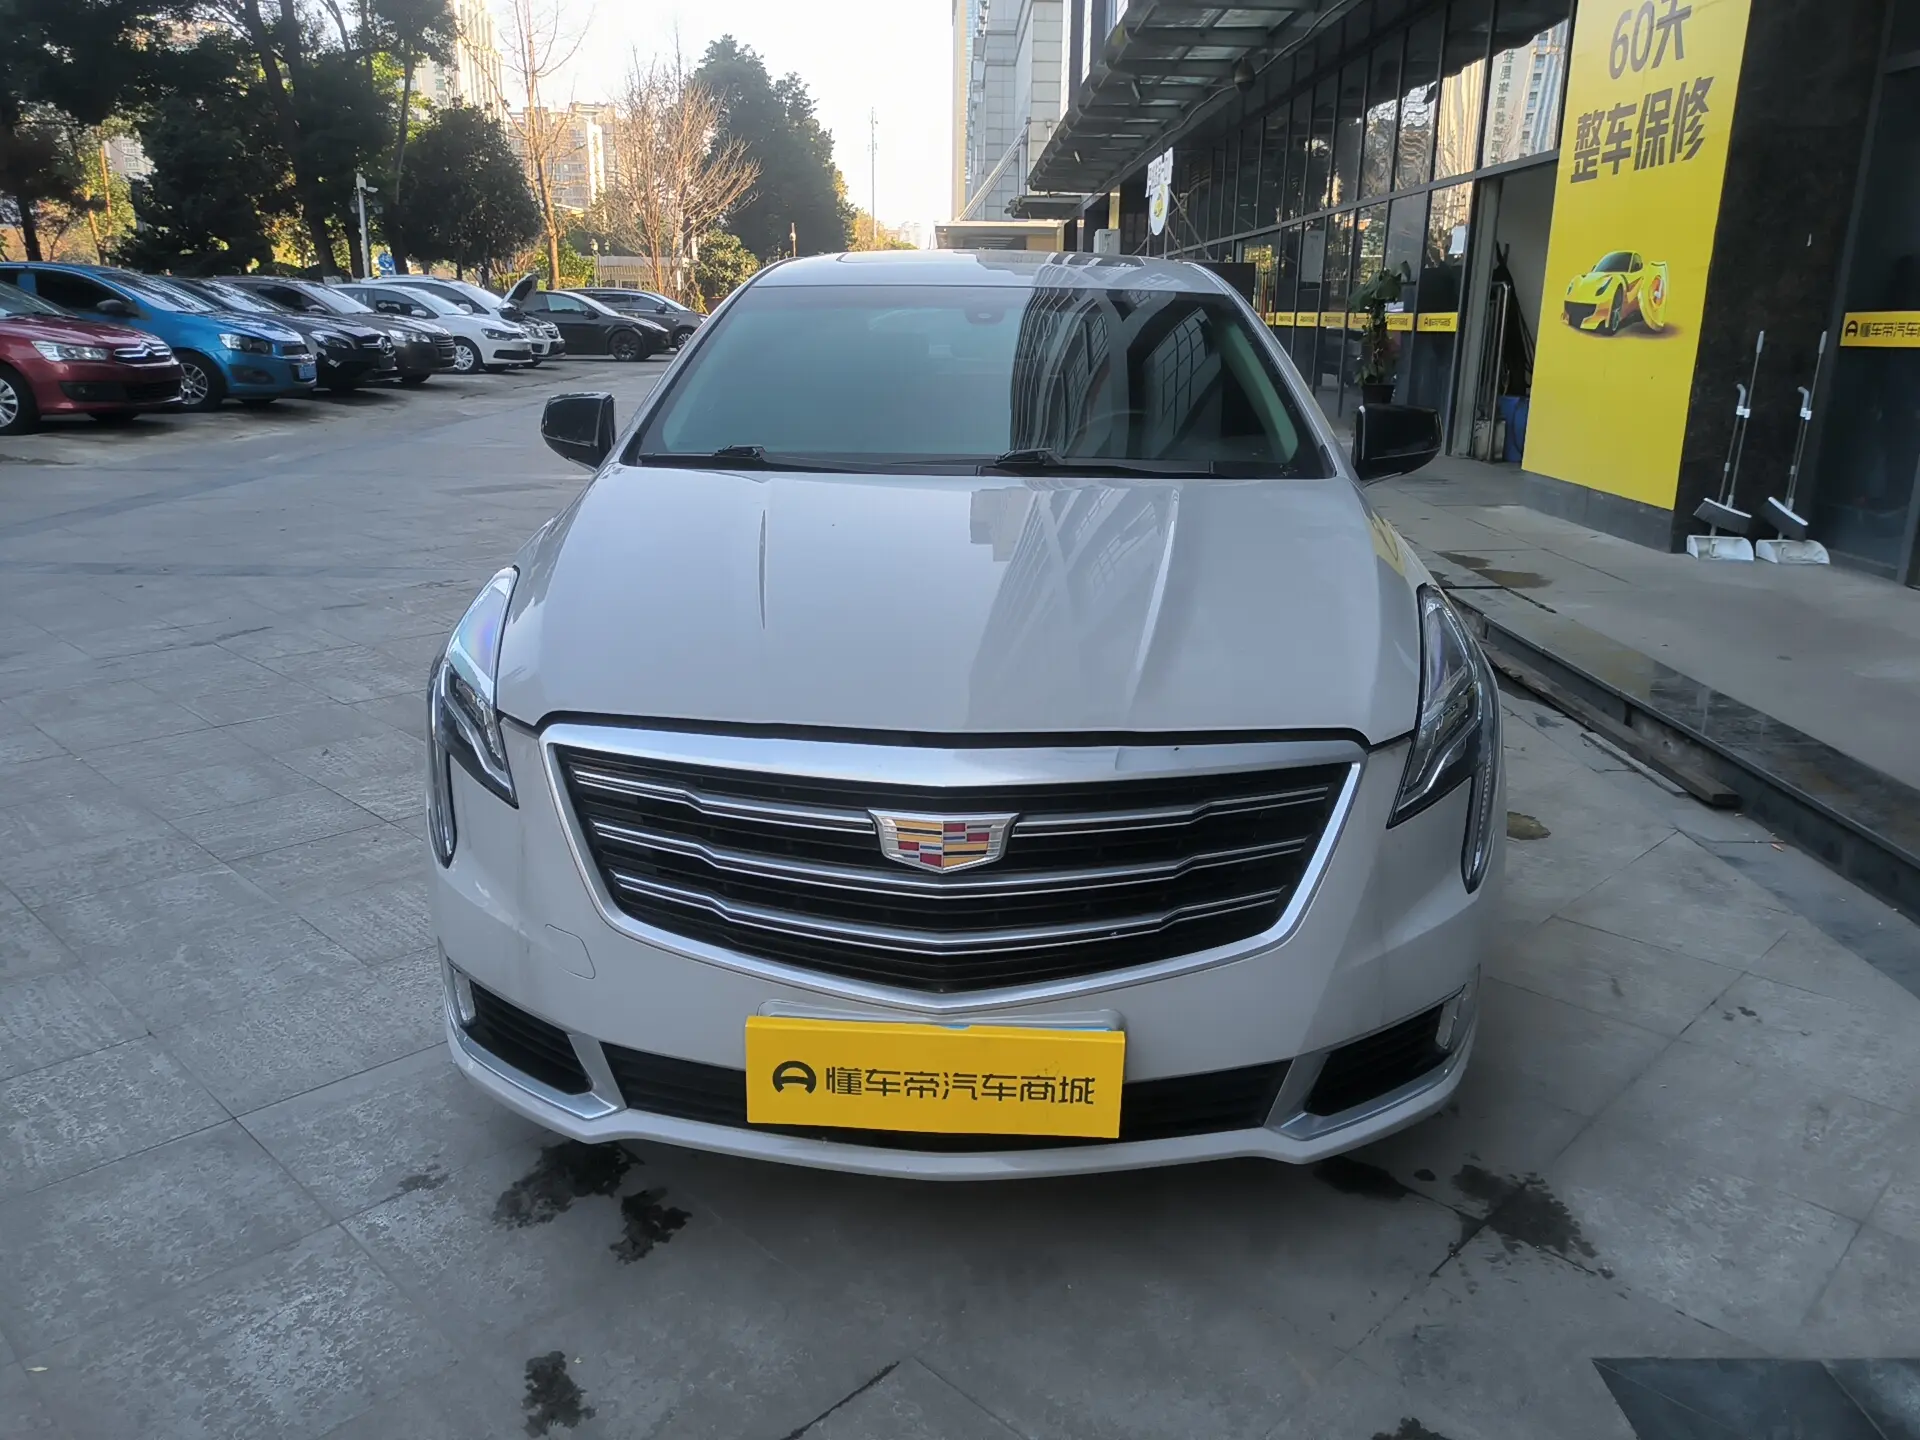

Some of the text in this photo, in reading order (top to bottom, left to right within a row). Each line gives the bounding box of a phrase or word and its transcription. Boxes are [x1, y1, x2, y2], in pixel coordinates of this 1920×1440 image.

[1609, 0, 1692, 80] 60天
[1570, 76, 1715, 183] 整车保修
[1860, 322, 1920, 337] 车帝汽车
[825, 1066, 1096, 1105] 懂车帝汽车商城
